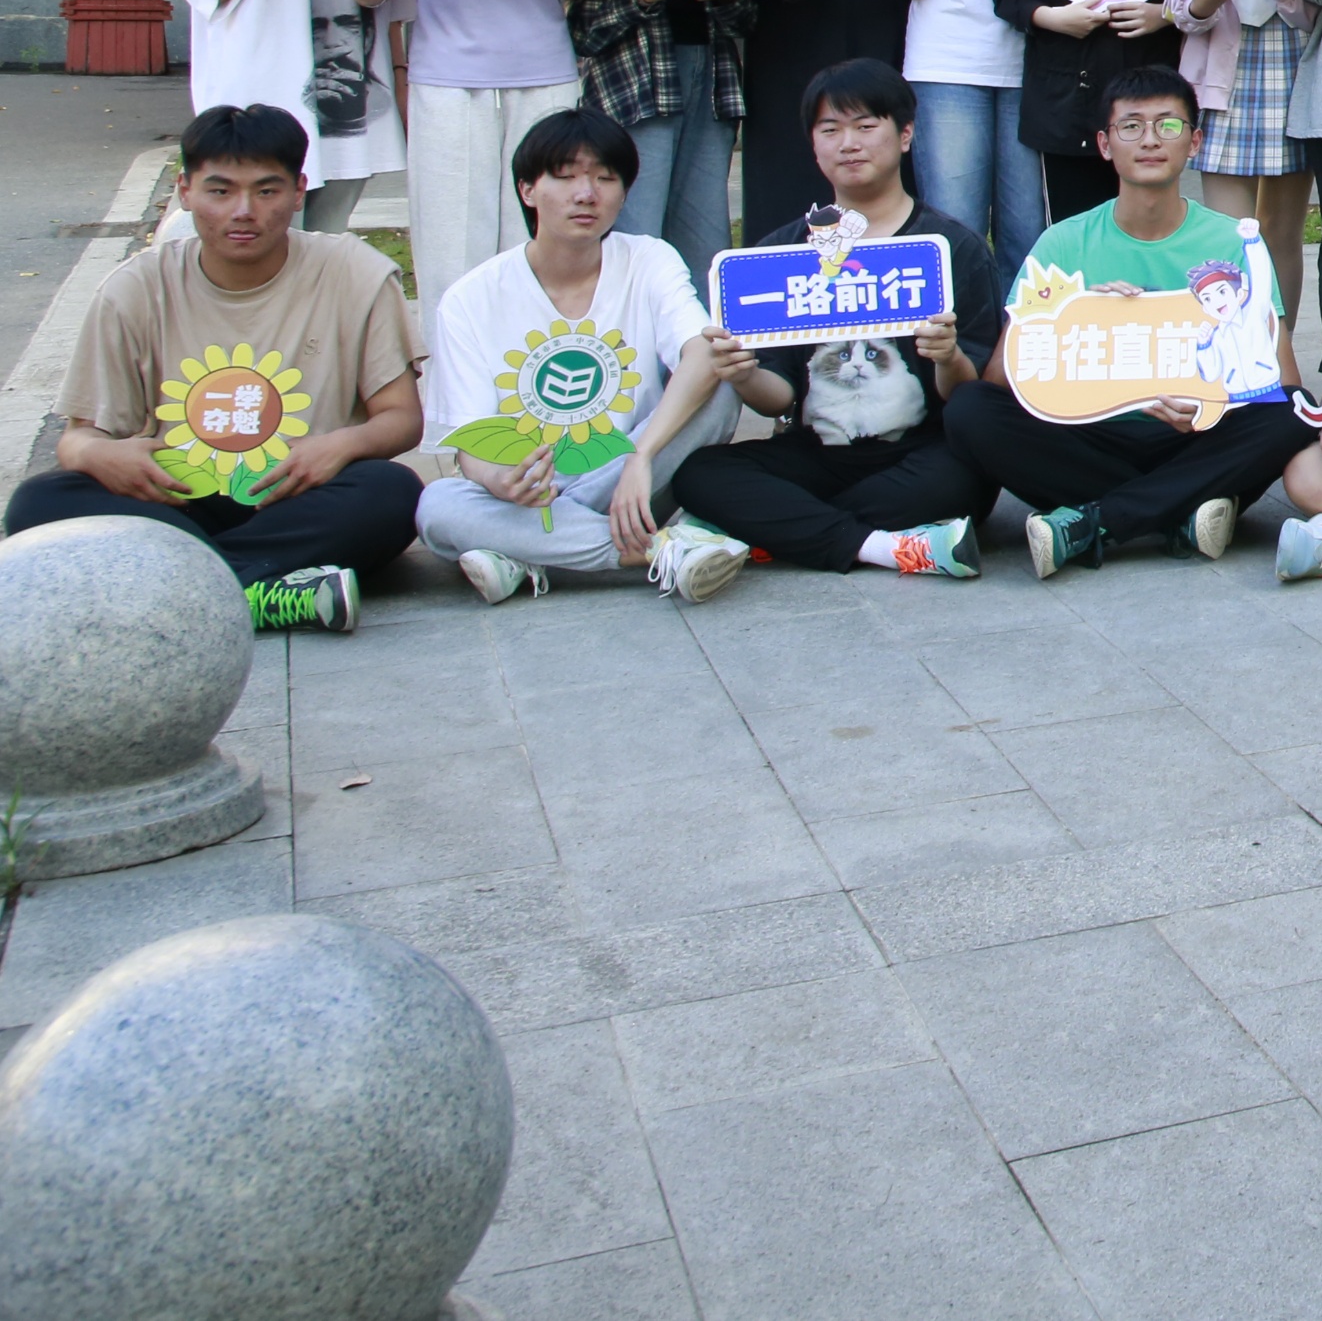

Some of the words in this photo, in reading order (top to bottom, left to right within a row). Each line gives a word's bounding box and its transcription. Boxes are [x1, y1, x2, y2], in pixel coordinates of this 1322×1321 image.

[739, 267, 927, 318] 一路前行
[1016, 321, 1201, 382] 勇往直前
[205, 384, 263, 410] 一举
[202, 408, 261, 435] 夺魁
